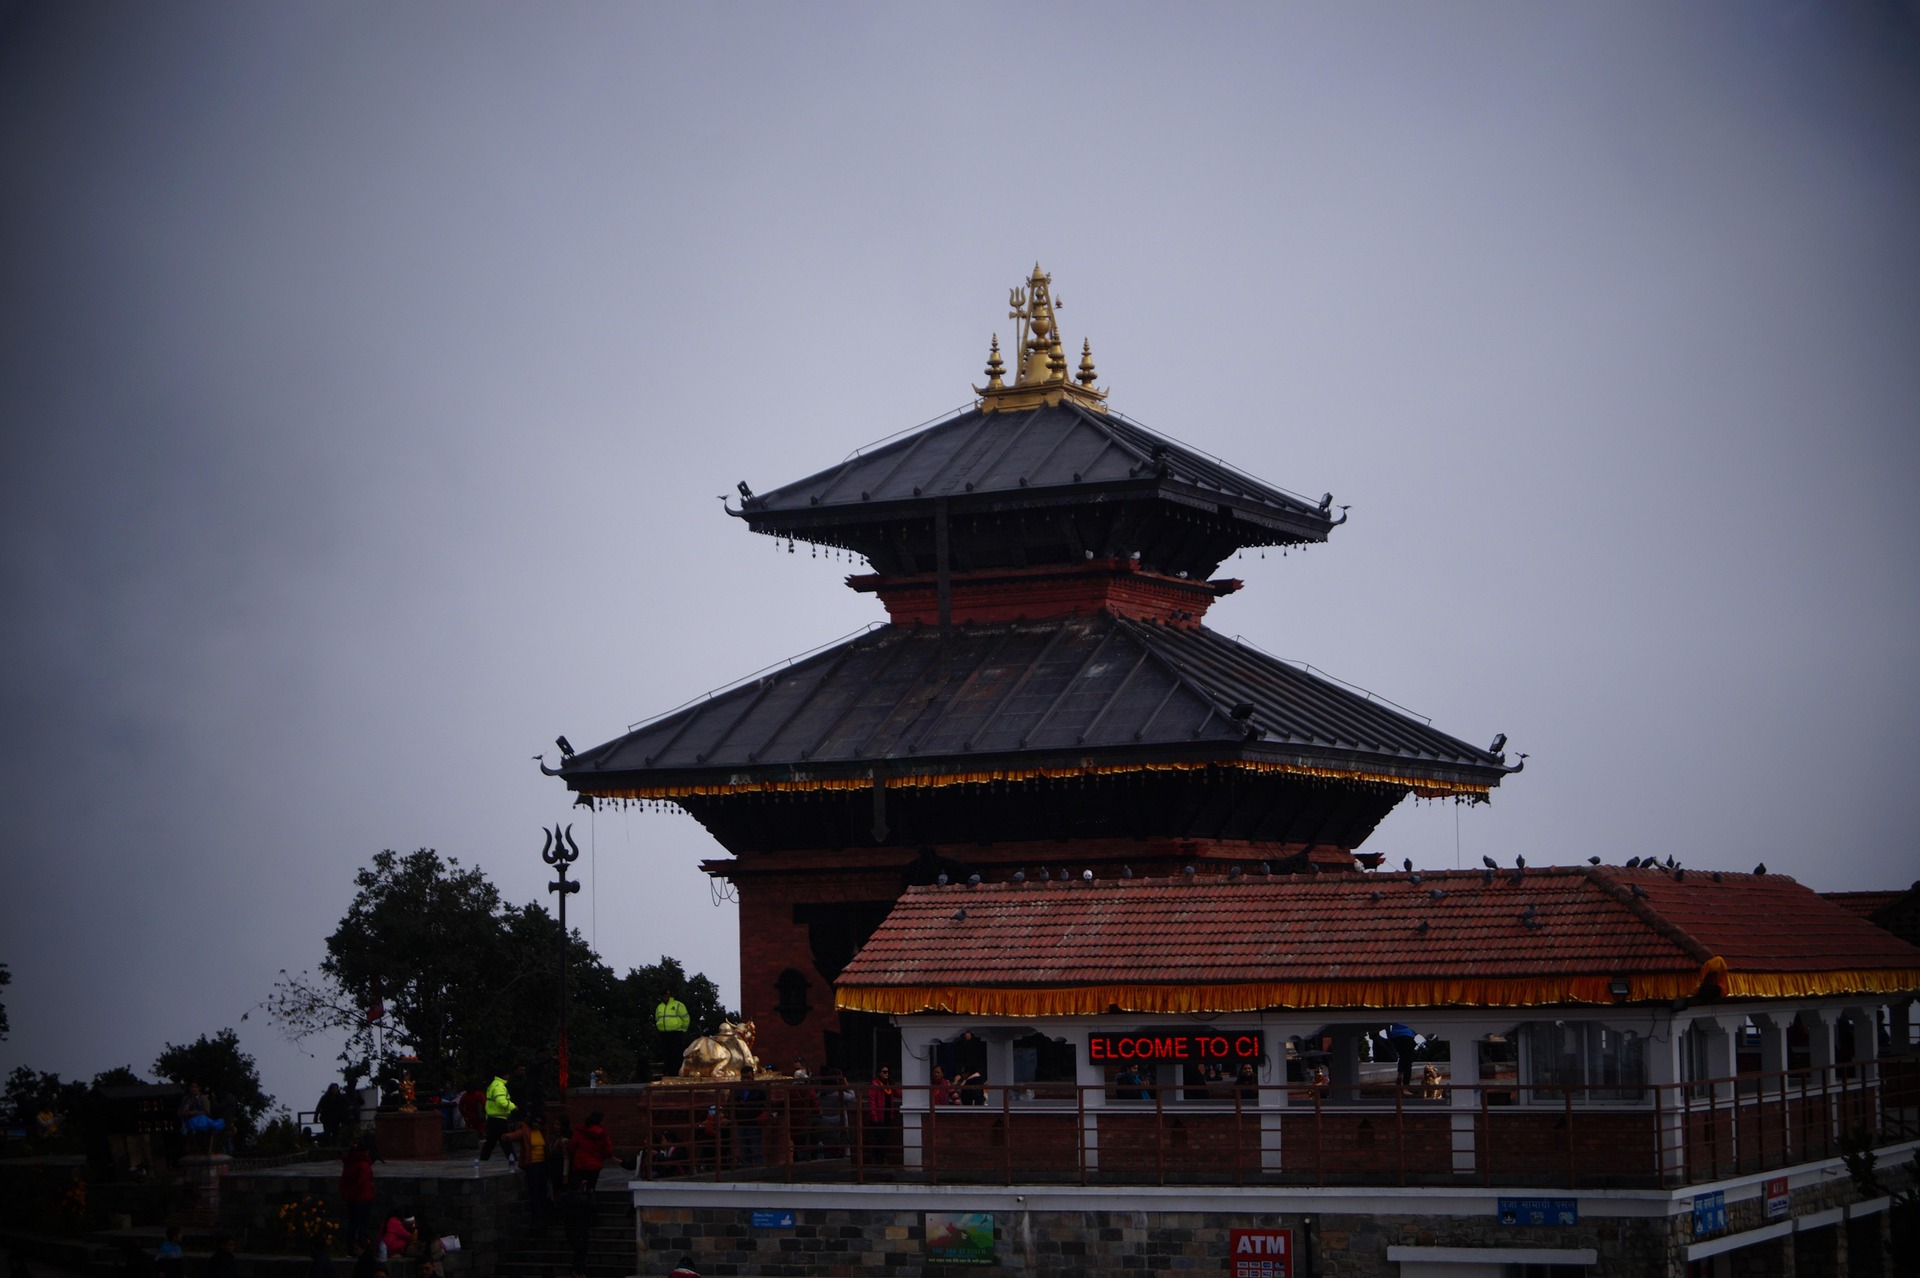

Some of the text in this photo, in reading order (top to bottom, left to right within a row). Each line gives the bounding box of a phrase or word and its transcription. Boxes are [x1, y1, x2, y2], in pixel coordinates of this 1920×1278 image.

[1090, 1037, 1189, 1059] ELCOME
[1195, 1036, 1230, 1058] TO
[1236, 1235, 1285, 1254] ATM
